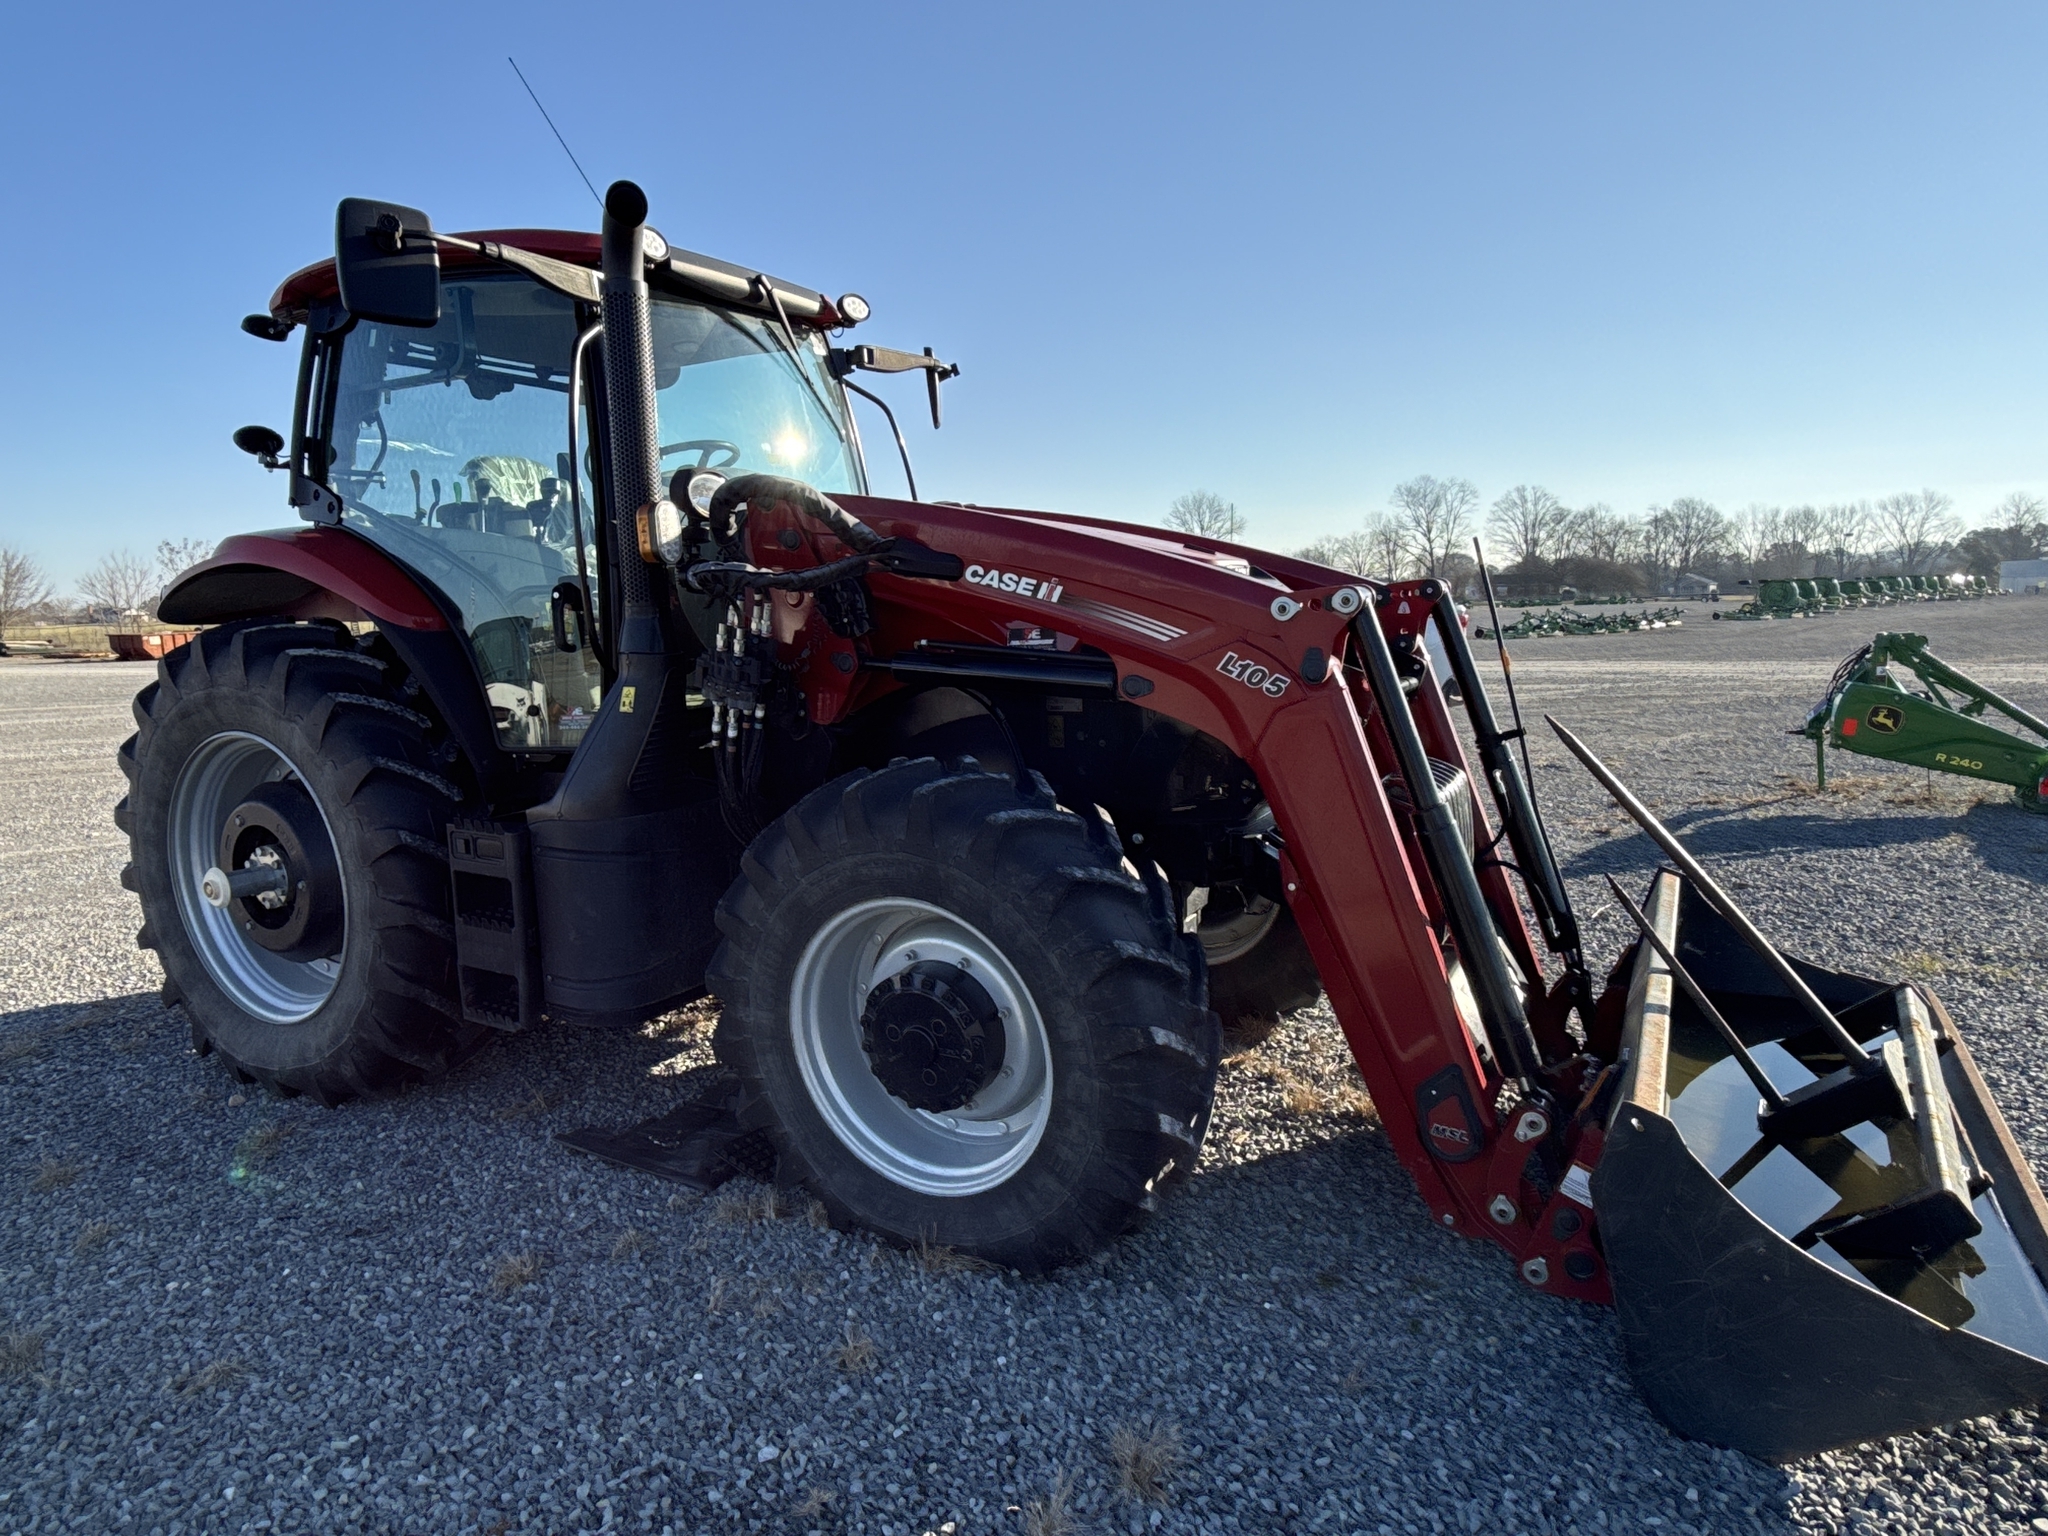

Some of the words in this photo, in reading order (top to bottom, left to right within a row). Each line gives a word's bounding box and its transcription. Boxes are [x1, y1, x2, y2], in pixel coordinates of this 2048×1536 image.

[965, 565, 1037, 597] CASE
[1215, 651, 1291, 697] L105
[1935, 752, 1947, 763] R
[1949, 756, 1983, 770] 240
